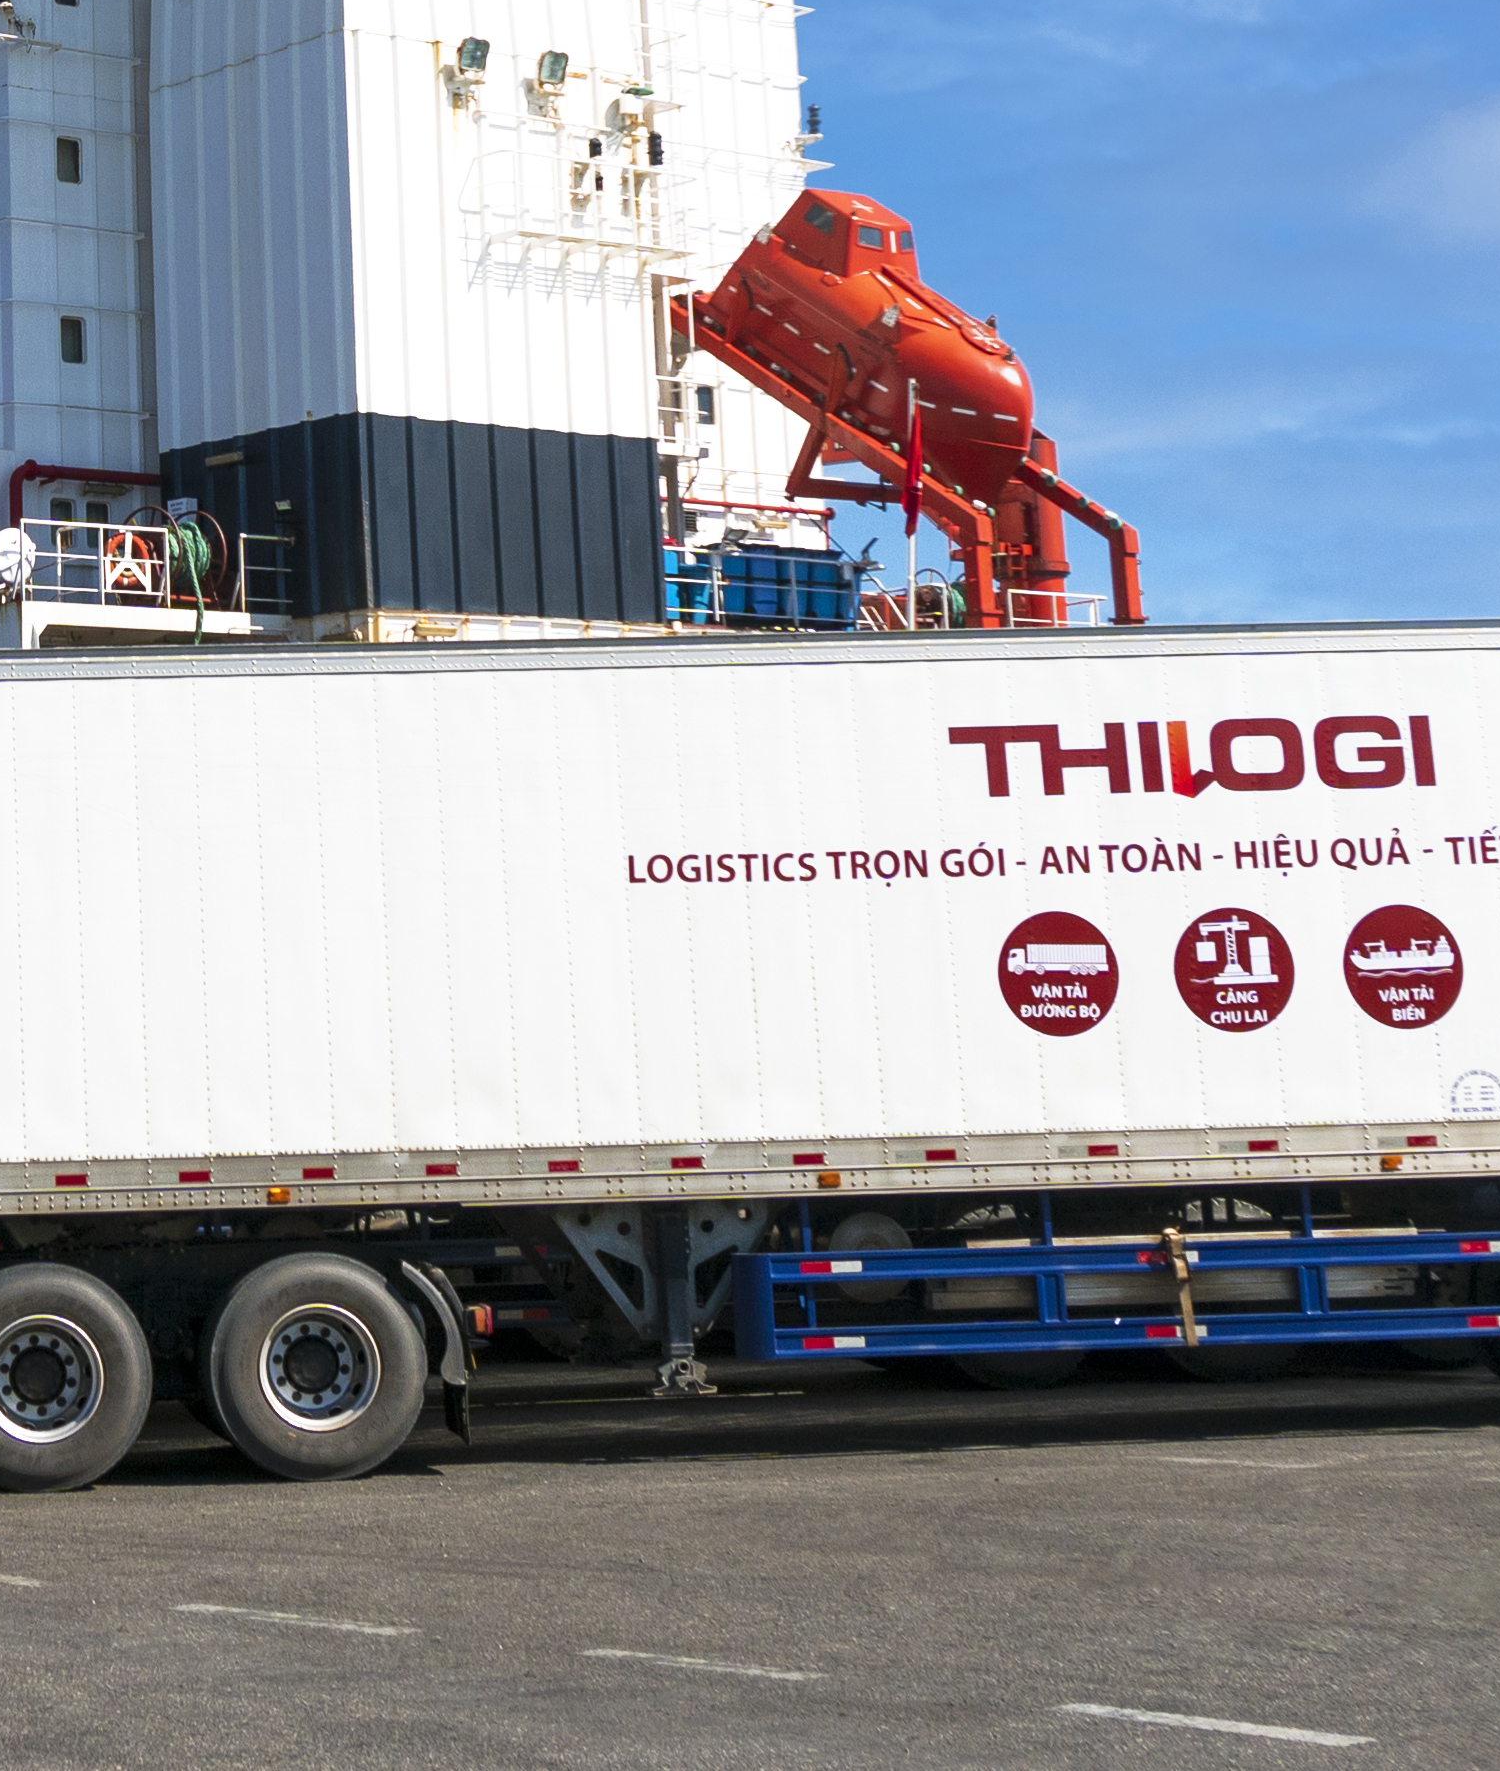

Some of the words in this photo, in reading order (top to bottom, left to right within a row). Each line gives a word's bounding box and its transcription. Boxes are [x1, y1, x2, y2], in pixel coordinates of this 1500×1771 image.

[947, 715, 1437, 799] THILOGI
[627, 852, 817, 884] LOGISTICS
[825, 849, 929, 888] TRỌN
[939, 841, 1006, 878] GÓI
[1040, 845, 1091, 875] AN
[1104, 836, 1202, 873] TOÀN
[1234, 833, 1319, 877] HIỆU
[1330, 827, 1411, 871] QUẢ
[1030, 983, 1063, 1002] VẬN
[1063, 981, 1088, 999] TẢI
[1215, 987, 1259, 1005] CẢNG
[1377, 986, 1410, 1006] VẬN
[1410, 983, 1435, 1001] TẢI
[1020, 1002, 1077, 1018] ĐƯỜNG
[1079, 1002, 1101, 1022] BỘ
[1210, 1010, 1242, 1025] CHU
[1244, 1009, 1269, 1023] LAI
[1392, 1003, 1426, 1022] BIỂN
